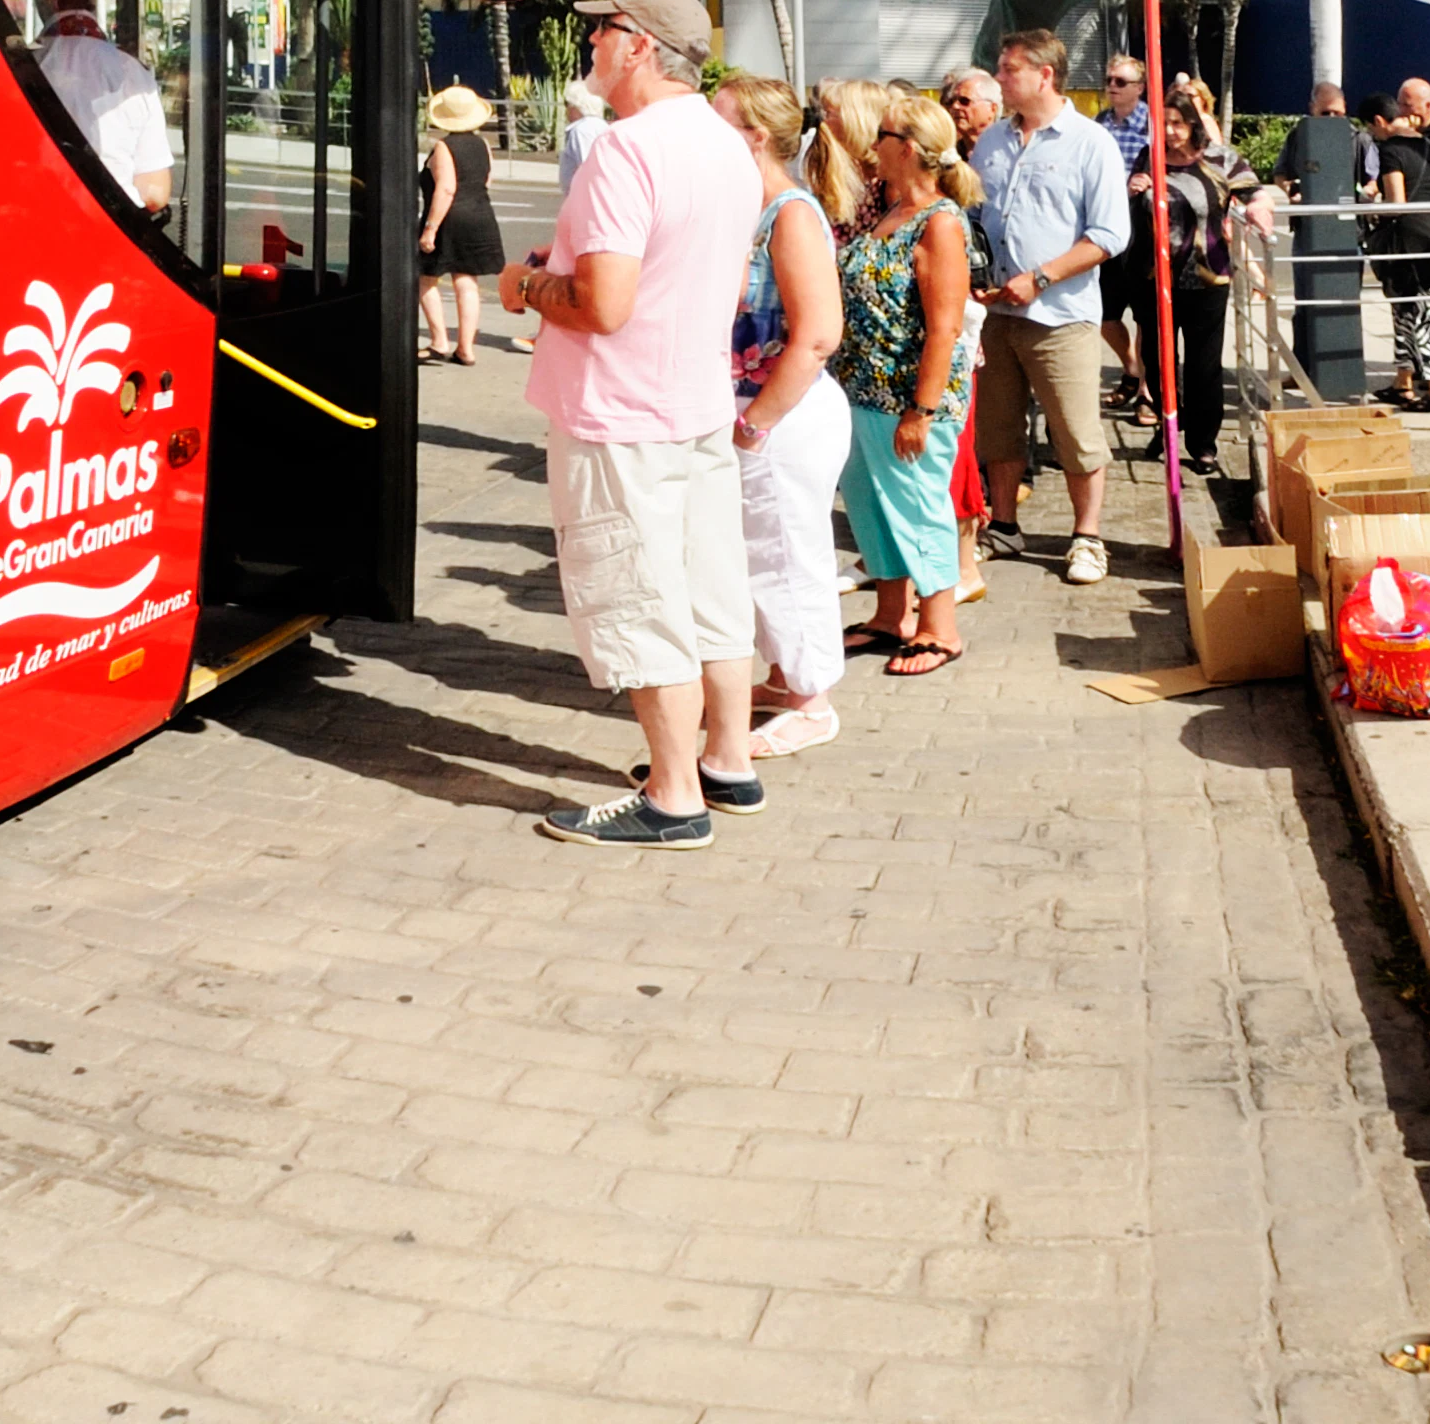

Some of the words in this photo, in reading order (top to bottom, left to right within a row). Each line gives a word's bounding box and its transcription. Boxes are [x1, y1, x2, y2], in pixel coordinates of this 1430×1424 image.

[24, 645, 52, 676] de
[55, 625, 101, 661] mar
[100, 621, 116, 649] y
[118, 588, 192, 633] culturas
